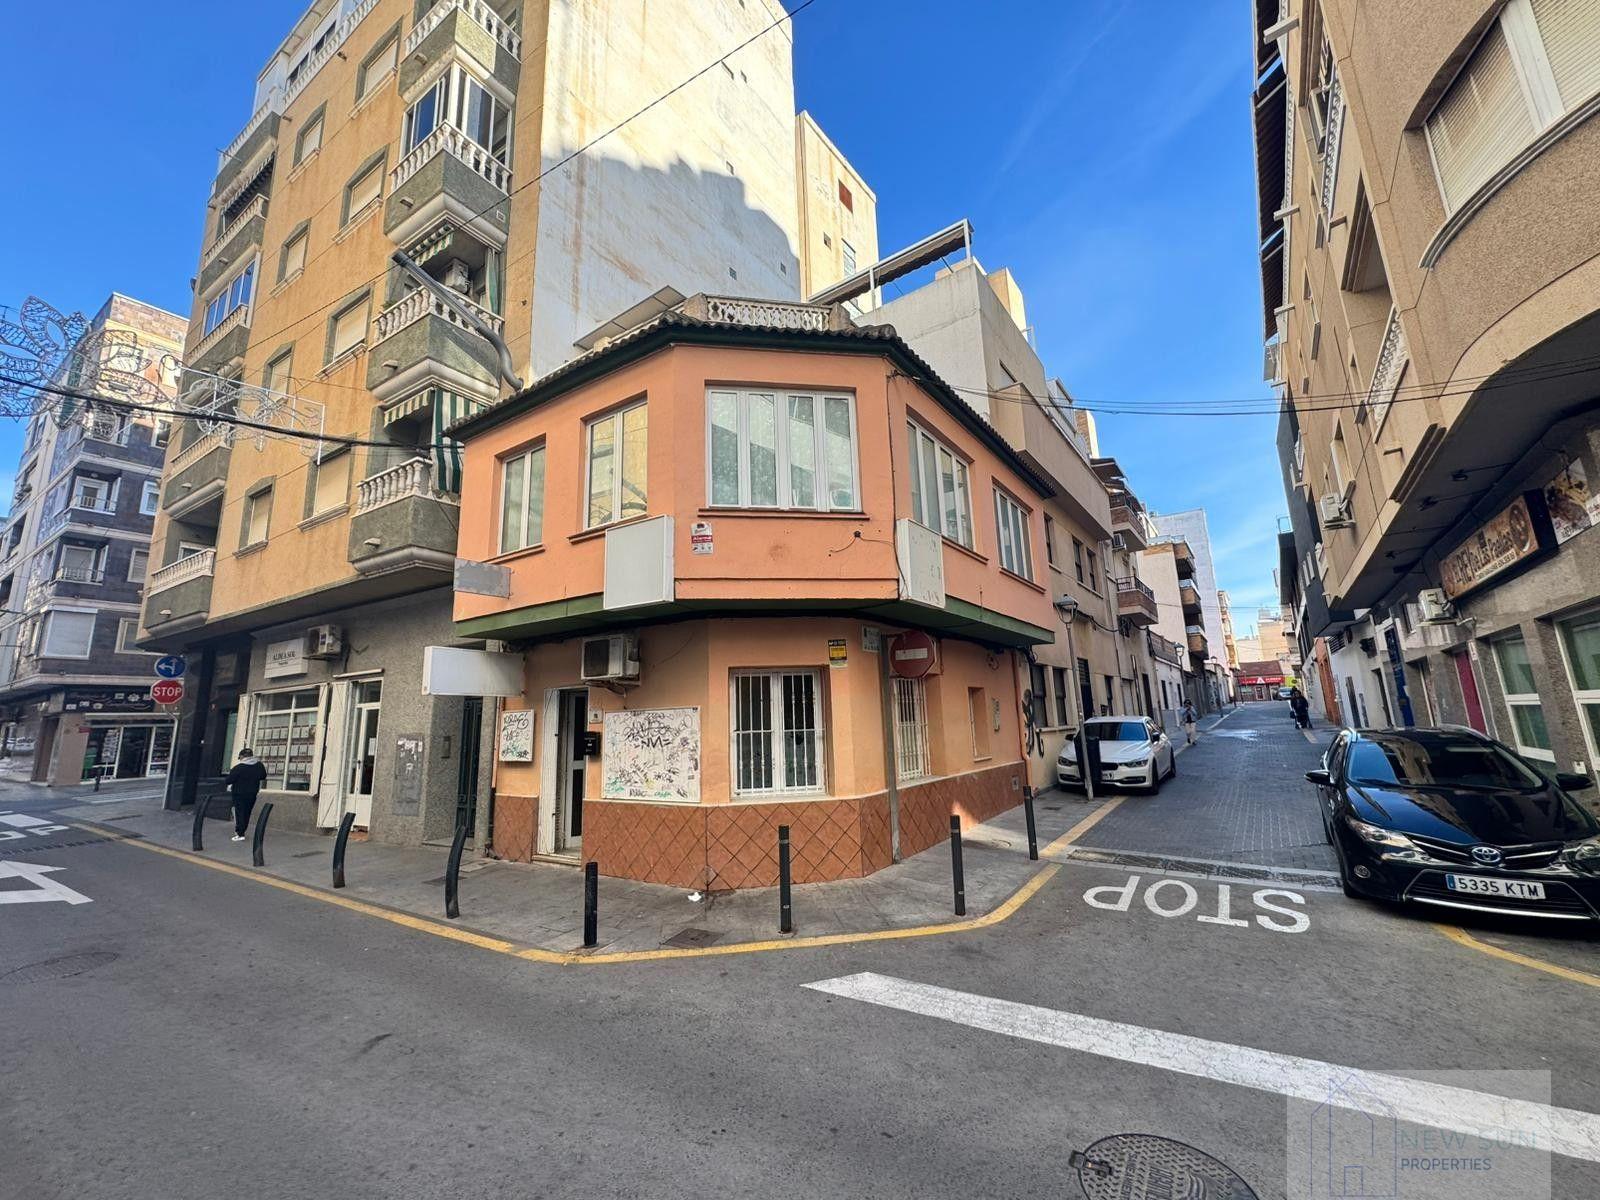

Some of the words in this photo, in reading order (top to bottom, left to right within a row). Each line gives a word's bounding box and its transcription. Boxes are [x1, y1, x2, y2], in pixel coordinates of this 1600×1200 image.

[153, 687, 182, 697] STOP
[1458, 877, 1500, 893] 5335
[1505, 882, 1539, 897] KTM
[1082, 875, 1311, 934] STOP
